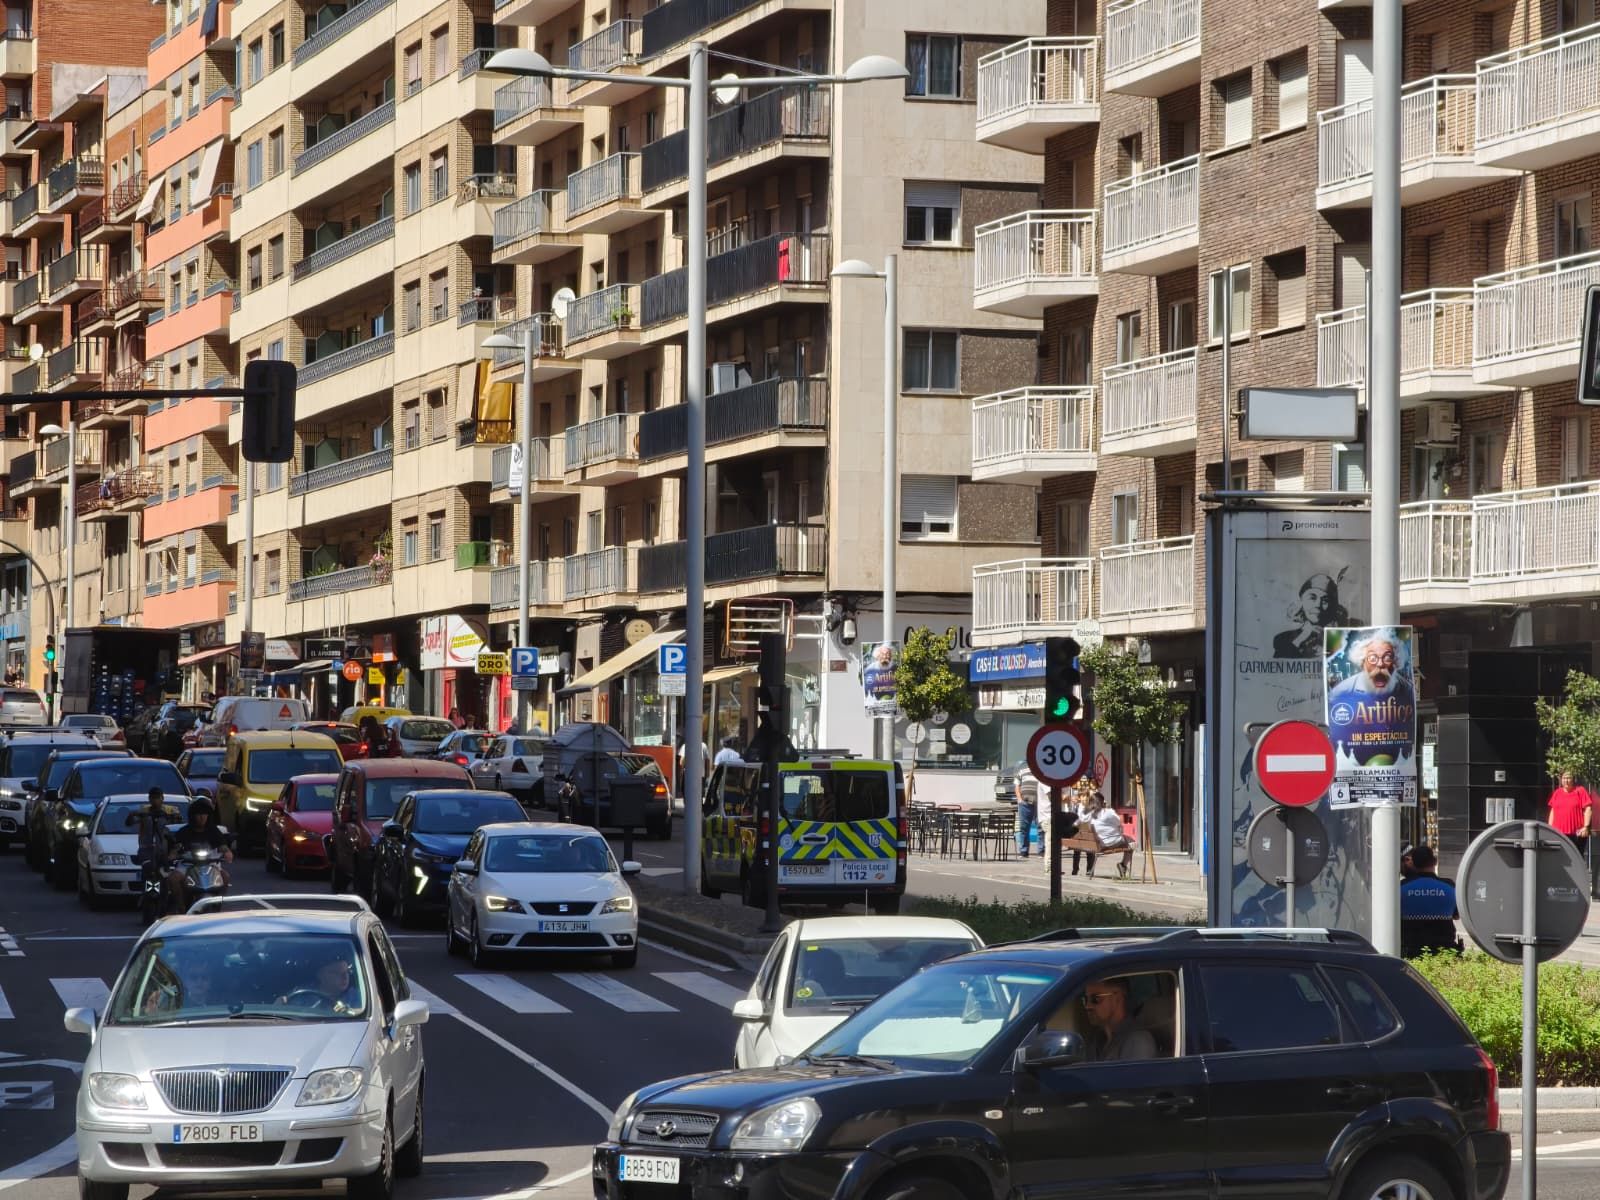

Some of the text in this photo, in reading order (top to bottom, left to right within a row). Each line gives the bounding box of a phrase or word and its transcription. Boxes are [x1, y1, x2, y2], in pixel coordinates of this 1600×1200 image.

[478, 660, 503, 669] ORO
[516, 650, 533, 673] P
[665, 647, 684, 672] P
[992, 656, 1000, 671] EL
[346, 665, 361, 675] ria
[1239, 660, 1284, 674] CARMEN
[1352, 732, 1363, 741] UN
[1042, 744, 1076, 766] 30
[1337, 789, 1344, 799] 6
[869, 862, 889, 871] Local
[846, 871, 867, 880] 112
[544, 922, 588, 931] 4134 JHM
[183, 1125, 258, 1141] 7809 FLB
[626, 1159, 676, 1181] 6859 FCX
